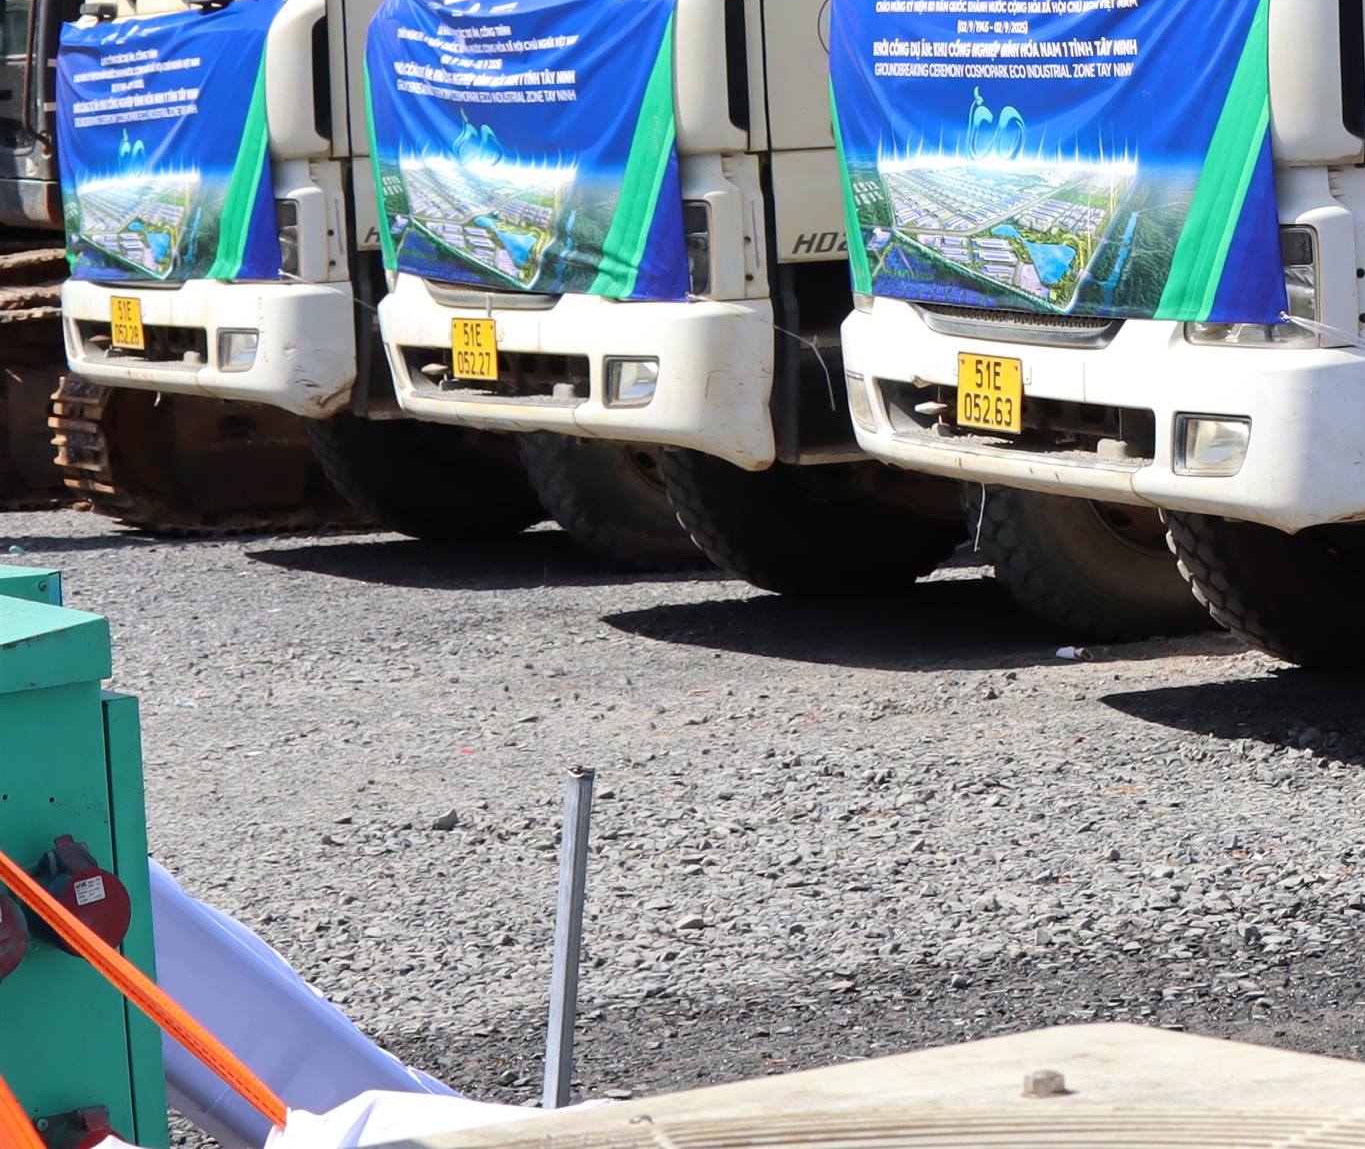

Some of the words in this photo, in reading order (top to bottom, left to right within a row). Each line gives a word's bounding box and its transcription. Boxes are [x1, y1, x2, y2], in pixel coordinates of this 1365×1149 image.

[1113, 40, 1138, 55] NINH
[464, 322, 482, 346] 51E
[976, 360, 1002, 390] 51E
[964, 392, 1012, 427] 052.63
